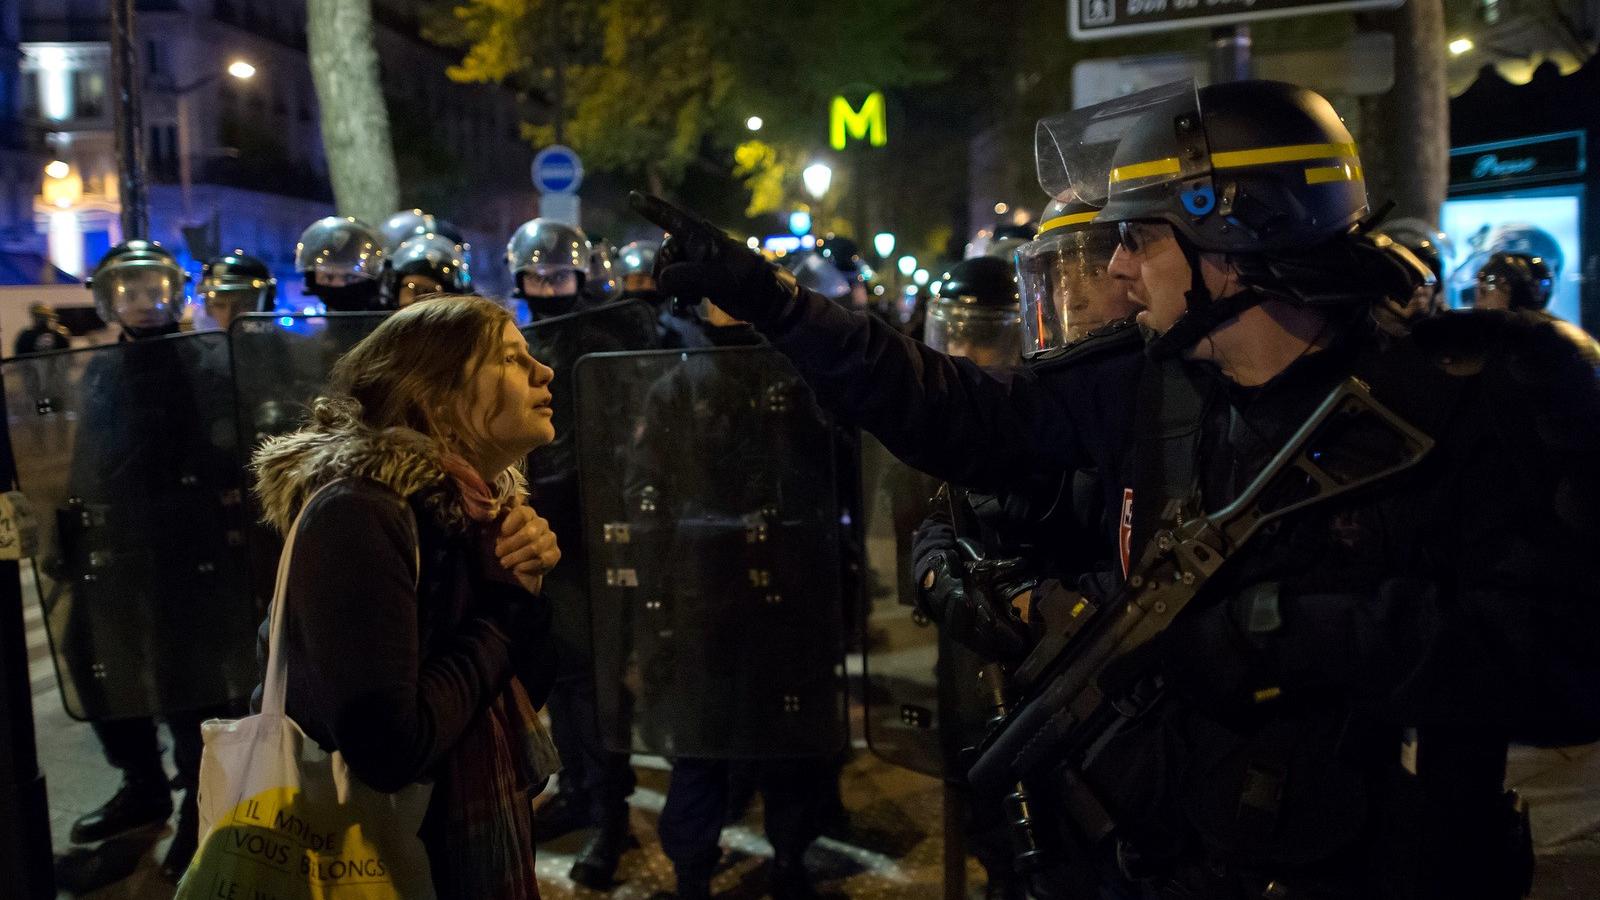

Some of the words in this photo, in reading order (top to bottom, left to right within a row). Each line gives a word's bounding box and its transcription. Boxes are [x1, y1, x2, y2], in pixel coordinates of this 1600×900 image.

[830, 92, 887, 151] M
[245, 799, 261, 820] IL
[234, 828, 290, 865] VOUS
